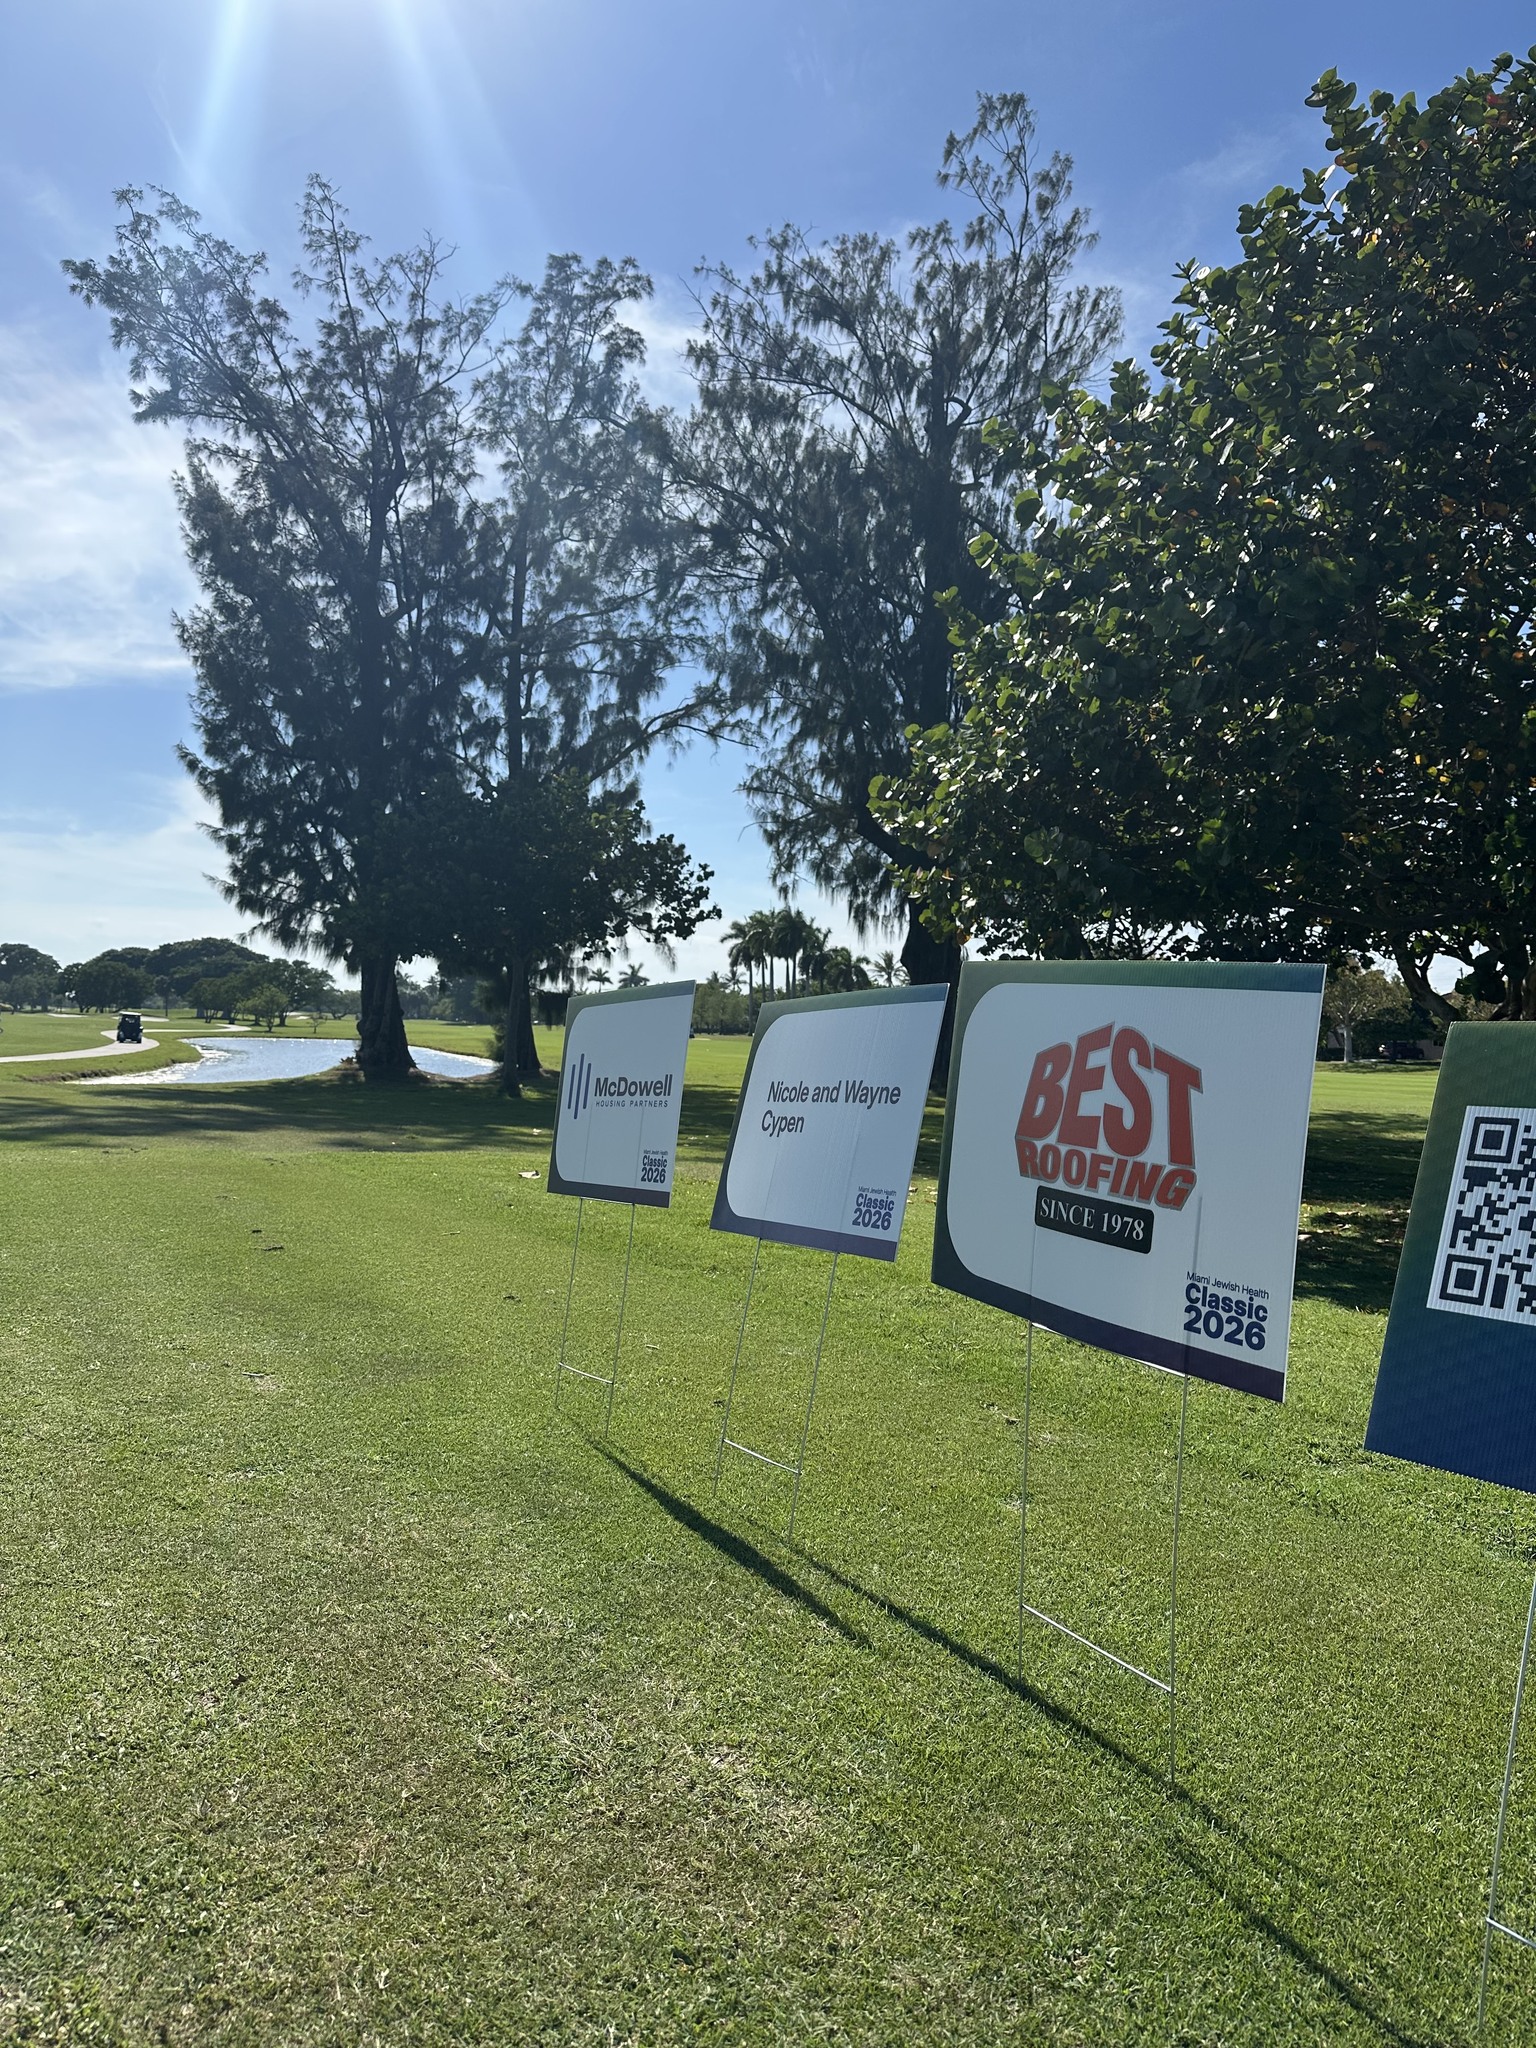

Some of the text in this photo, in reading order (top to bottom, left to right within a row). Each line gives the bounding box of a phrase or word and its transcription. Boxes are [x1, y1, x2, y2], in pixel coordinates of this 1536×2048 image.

[594, 1074, 673, 1097] McDowell
[767, 1080, 902, 1110] Nicole and Wayne
[1015, 1021, 1203, 1169] BEST
[595, 1100, 669, 1108] HOUSING PARTNERS
[761, 1109, 805, 1138] Cypen
[641, 1167, 666, 1183] 2026
[642, 1155, 668, 1168] Classic
[1015, 1138, 1197, 1211] ROOFING
[856, 1193, 895, 1212] Classic
[852, 1208, 892, 1231] 2026
[1040, 1197, 1145, 1241] SINCE 1978
[1187, 1271, 1269, 1300] Miami Jewish Health
[1185, 1282, 1268, 1323] Classic
[1183, 1305, 1266, 1351] 2026
